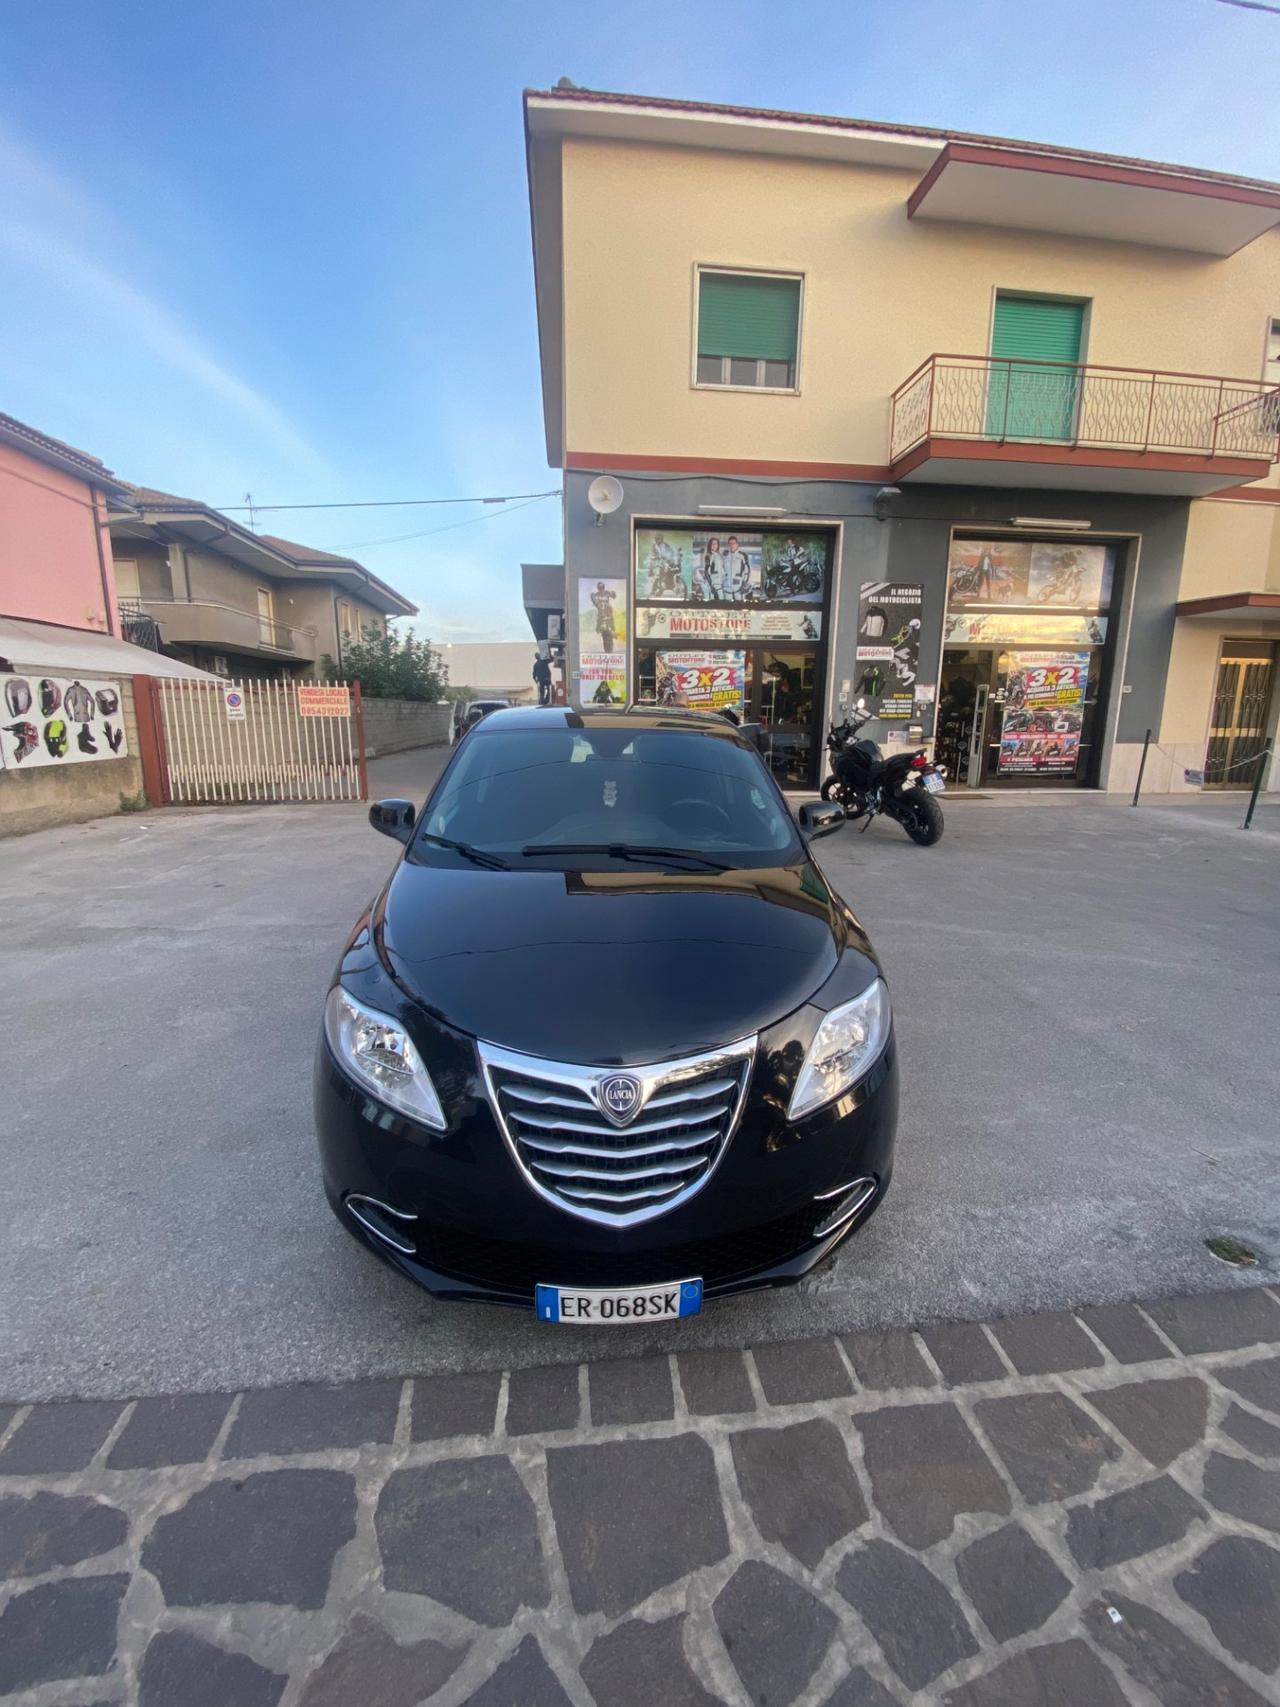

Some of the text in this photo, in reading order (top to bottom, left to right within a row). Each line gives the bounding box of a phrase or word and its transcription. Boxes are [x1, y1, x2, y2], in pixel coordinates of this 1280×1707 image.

[880, 596, 921, 604] MOTOCICLISTA
[670, 618, 751, 631] MOTOSTORE
[609, 1090, 633, 1100] LANCIA
[560, 1293, 678, 1319] ER 068SK
